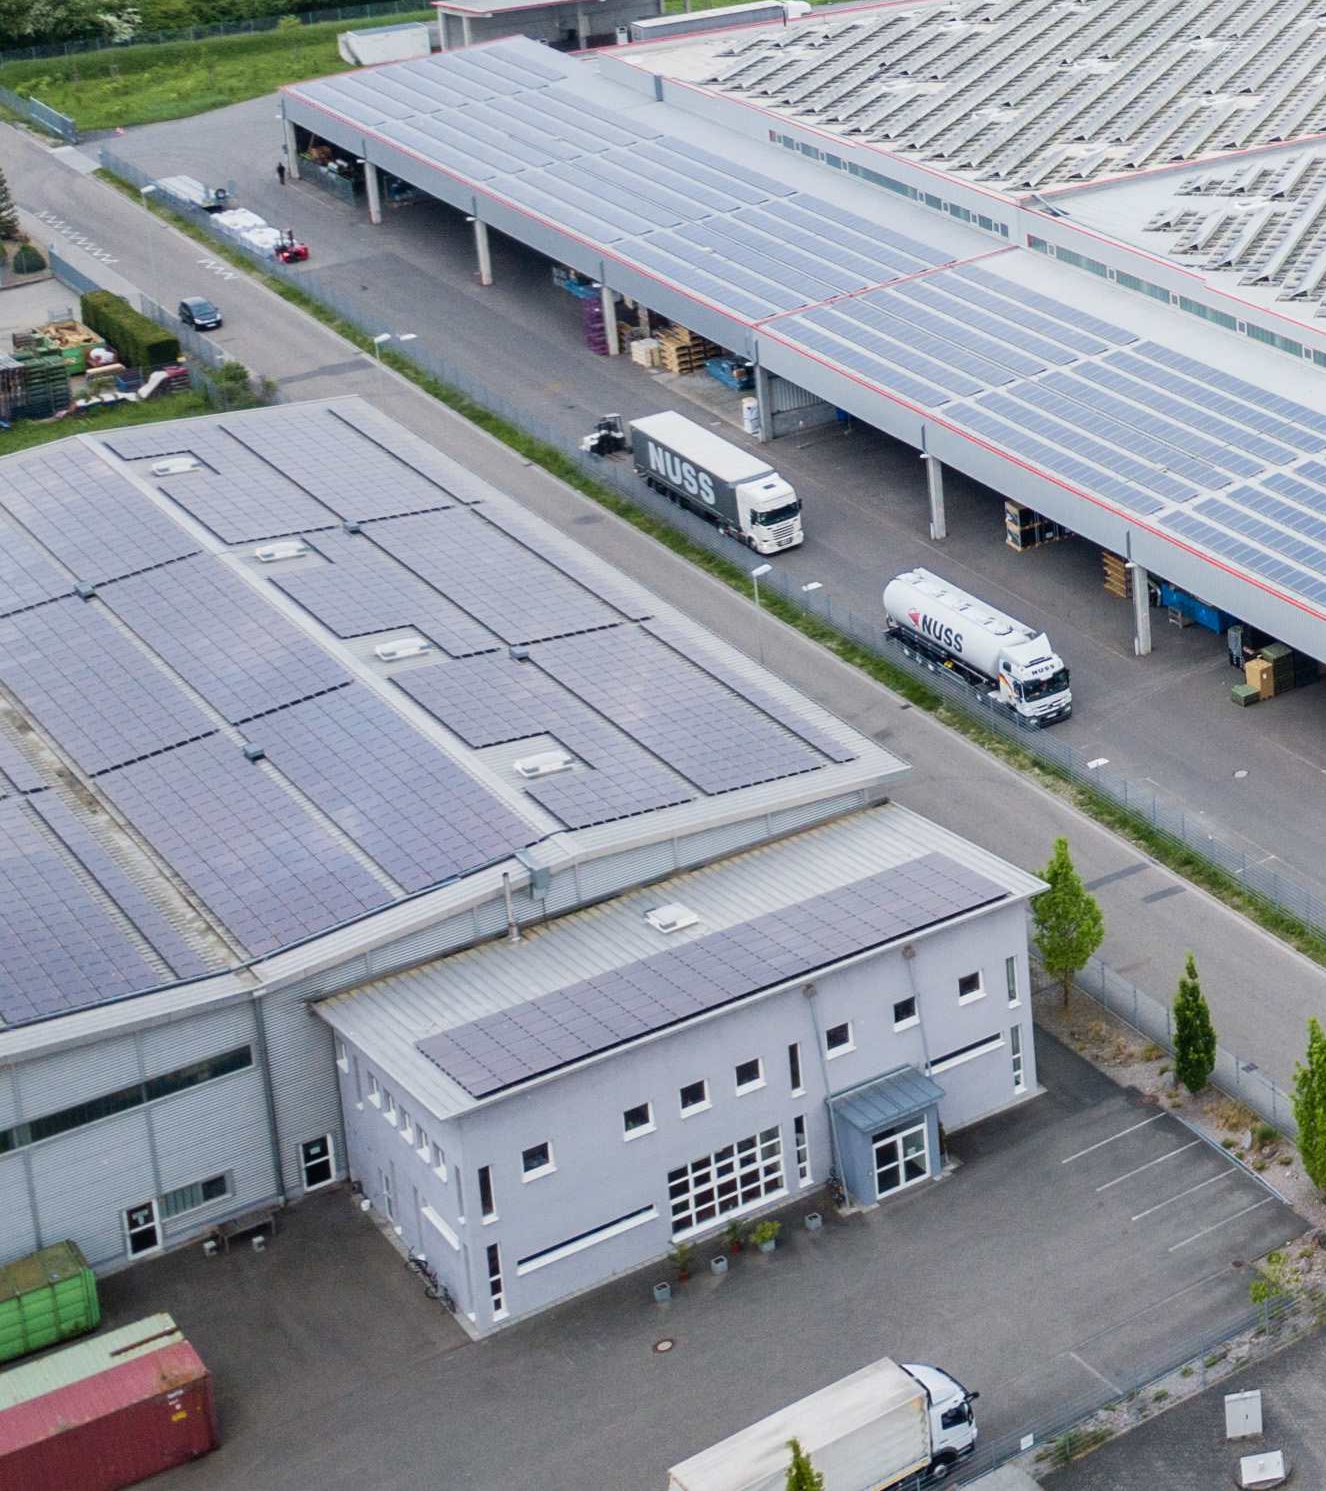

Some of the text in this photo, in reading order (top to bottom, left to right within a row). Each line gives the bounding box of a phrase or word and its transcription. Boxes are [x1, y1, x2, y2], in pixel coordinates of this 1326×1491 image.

[647, 441, 716, 505] NUSS
[922, 614, 963, 653] NUSS
[1031, 664, 1056, 676] NUSS
